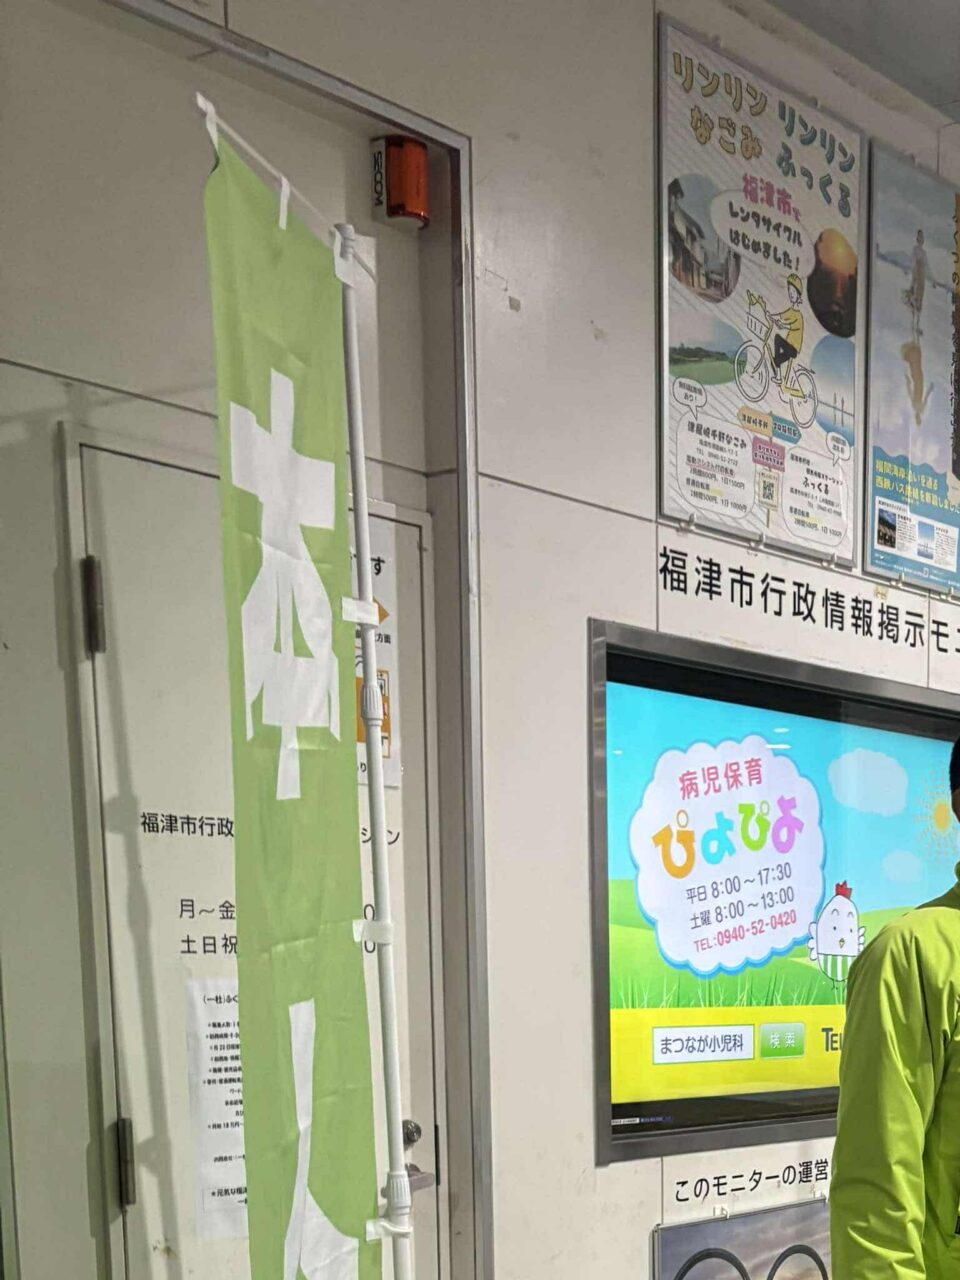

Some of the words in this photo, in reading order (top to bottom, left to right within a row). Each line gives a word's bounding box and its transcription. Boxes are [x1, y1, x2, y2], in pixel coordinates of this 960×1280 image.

[672, 51, 767, 117] リンリン
[691, 105, 763, 160] なごみ
[778, 101, 856, 174] リンリン
[776, 142, 852, 219] ふっくる
[729, 201, 803, 247] レンタサイクル
[679, 757, 763, 800] 病児保育
[141, 812, 234, 838] 福津市行政
[179, 898, 236, 920] 月～金
[686, 885, 707, 904] 平日
[690, 909, 712, 930] 土曜
[180, 934, 238, 955] 土日祝
[660, 1033, 744, 1055] まつなが小児科
[769, 1032, 796, 1049] 検索
[674, 1158, 829, 1203] このモニターの運営
